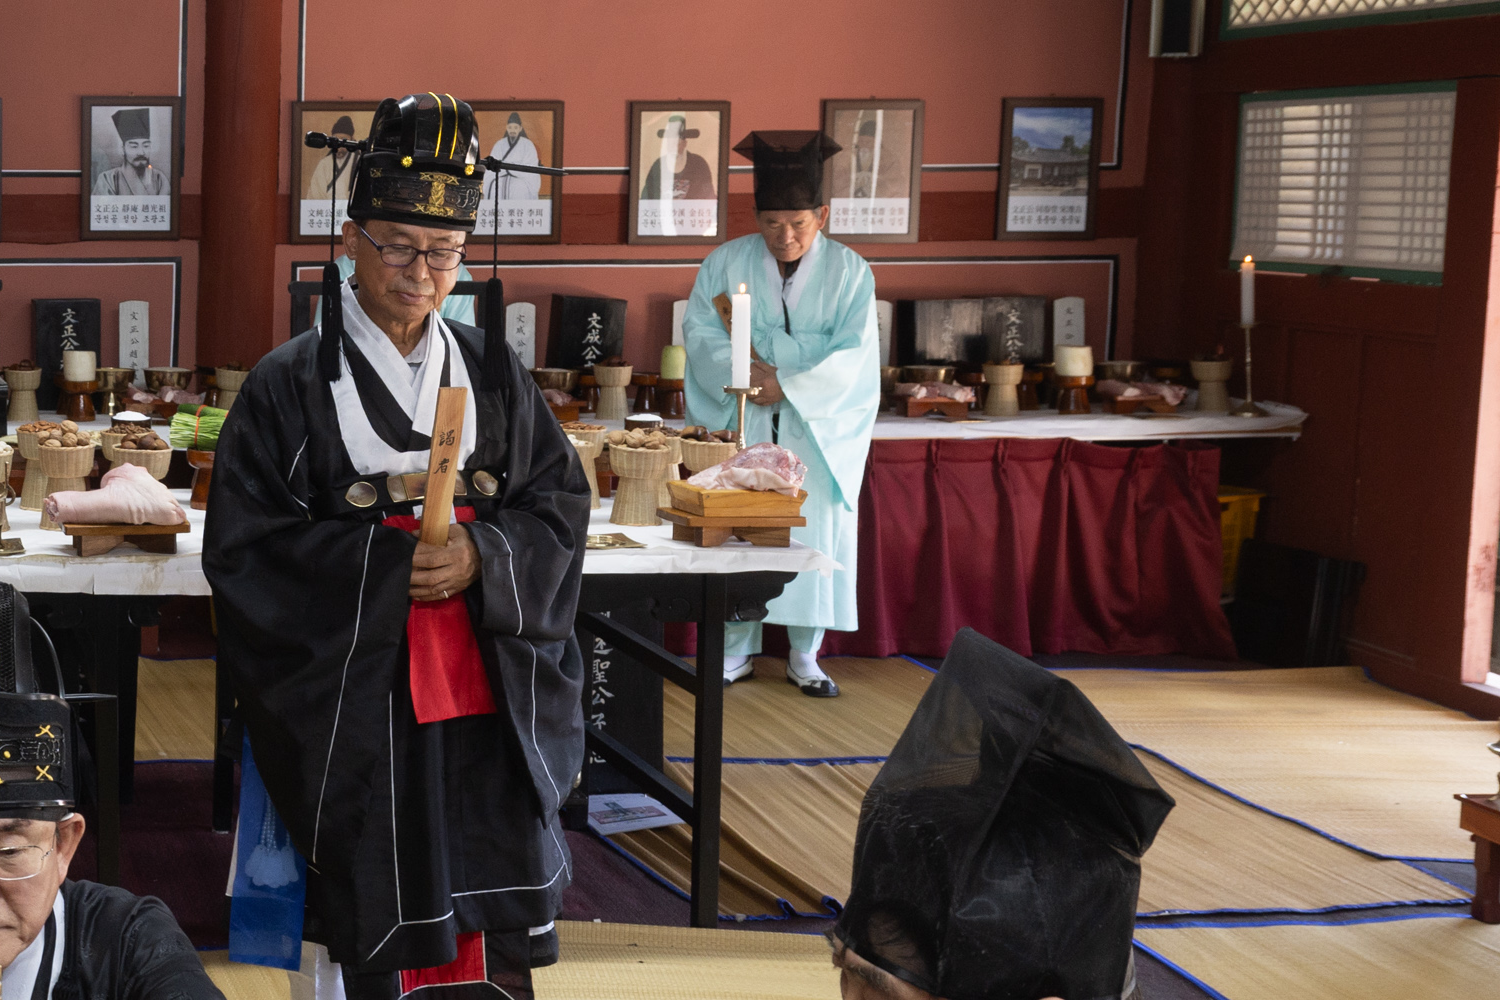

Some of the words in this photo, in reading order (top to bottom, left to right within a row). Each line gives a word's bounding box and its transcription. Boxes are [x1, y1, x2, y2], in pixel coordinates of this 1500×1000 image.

[95, 204, 119, 213] 文正公
[141, 204, 166, 213] 趙光祖
[527, 208, 543, 217] 李珥
[95, 214, 118, 224] 문정공
[123, 214, 138, 224] 정암
[143, 214, 166, 224] 조광조
[308, 219, 331, 228] 문순공
[508, 218, 523, 228] 율곡
[527, 218, 542, 228] 이이
[60, 308, 80, 370] 文正公
[434, 429, 455, 474] 謁者
